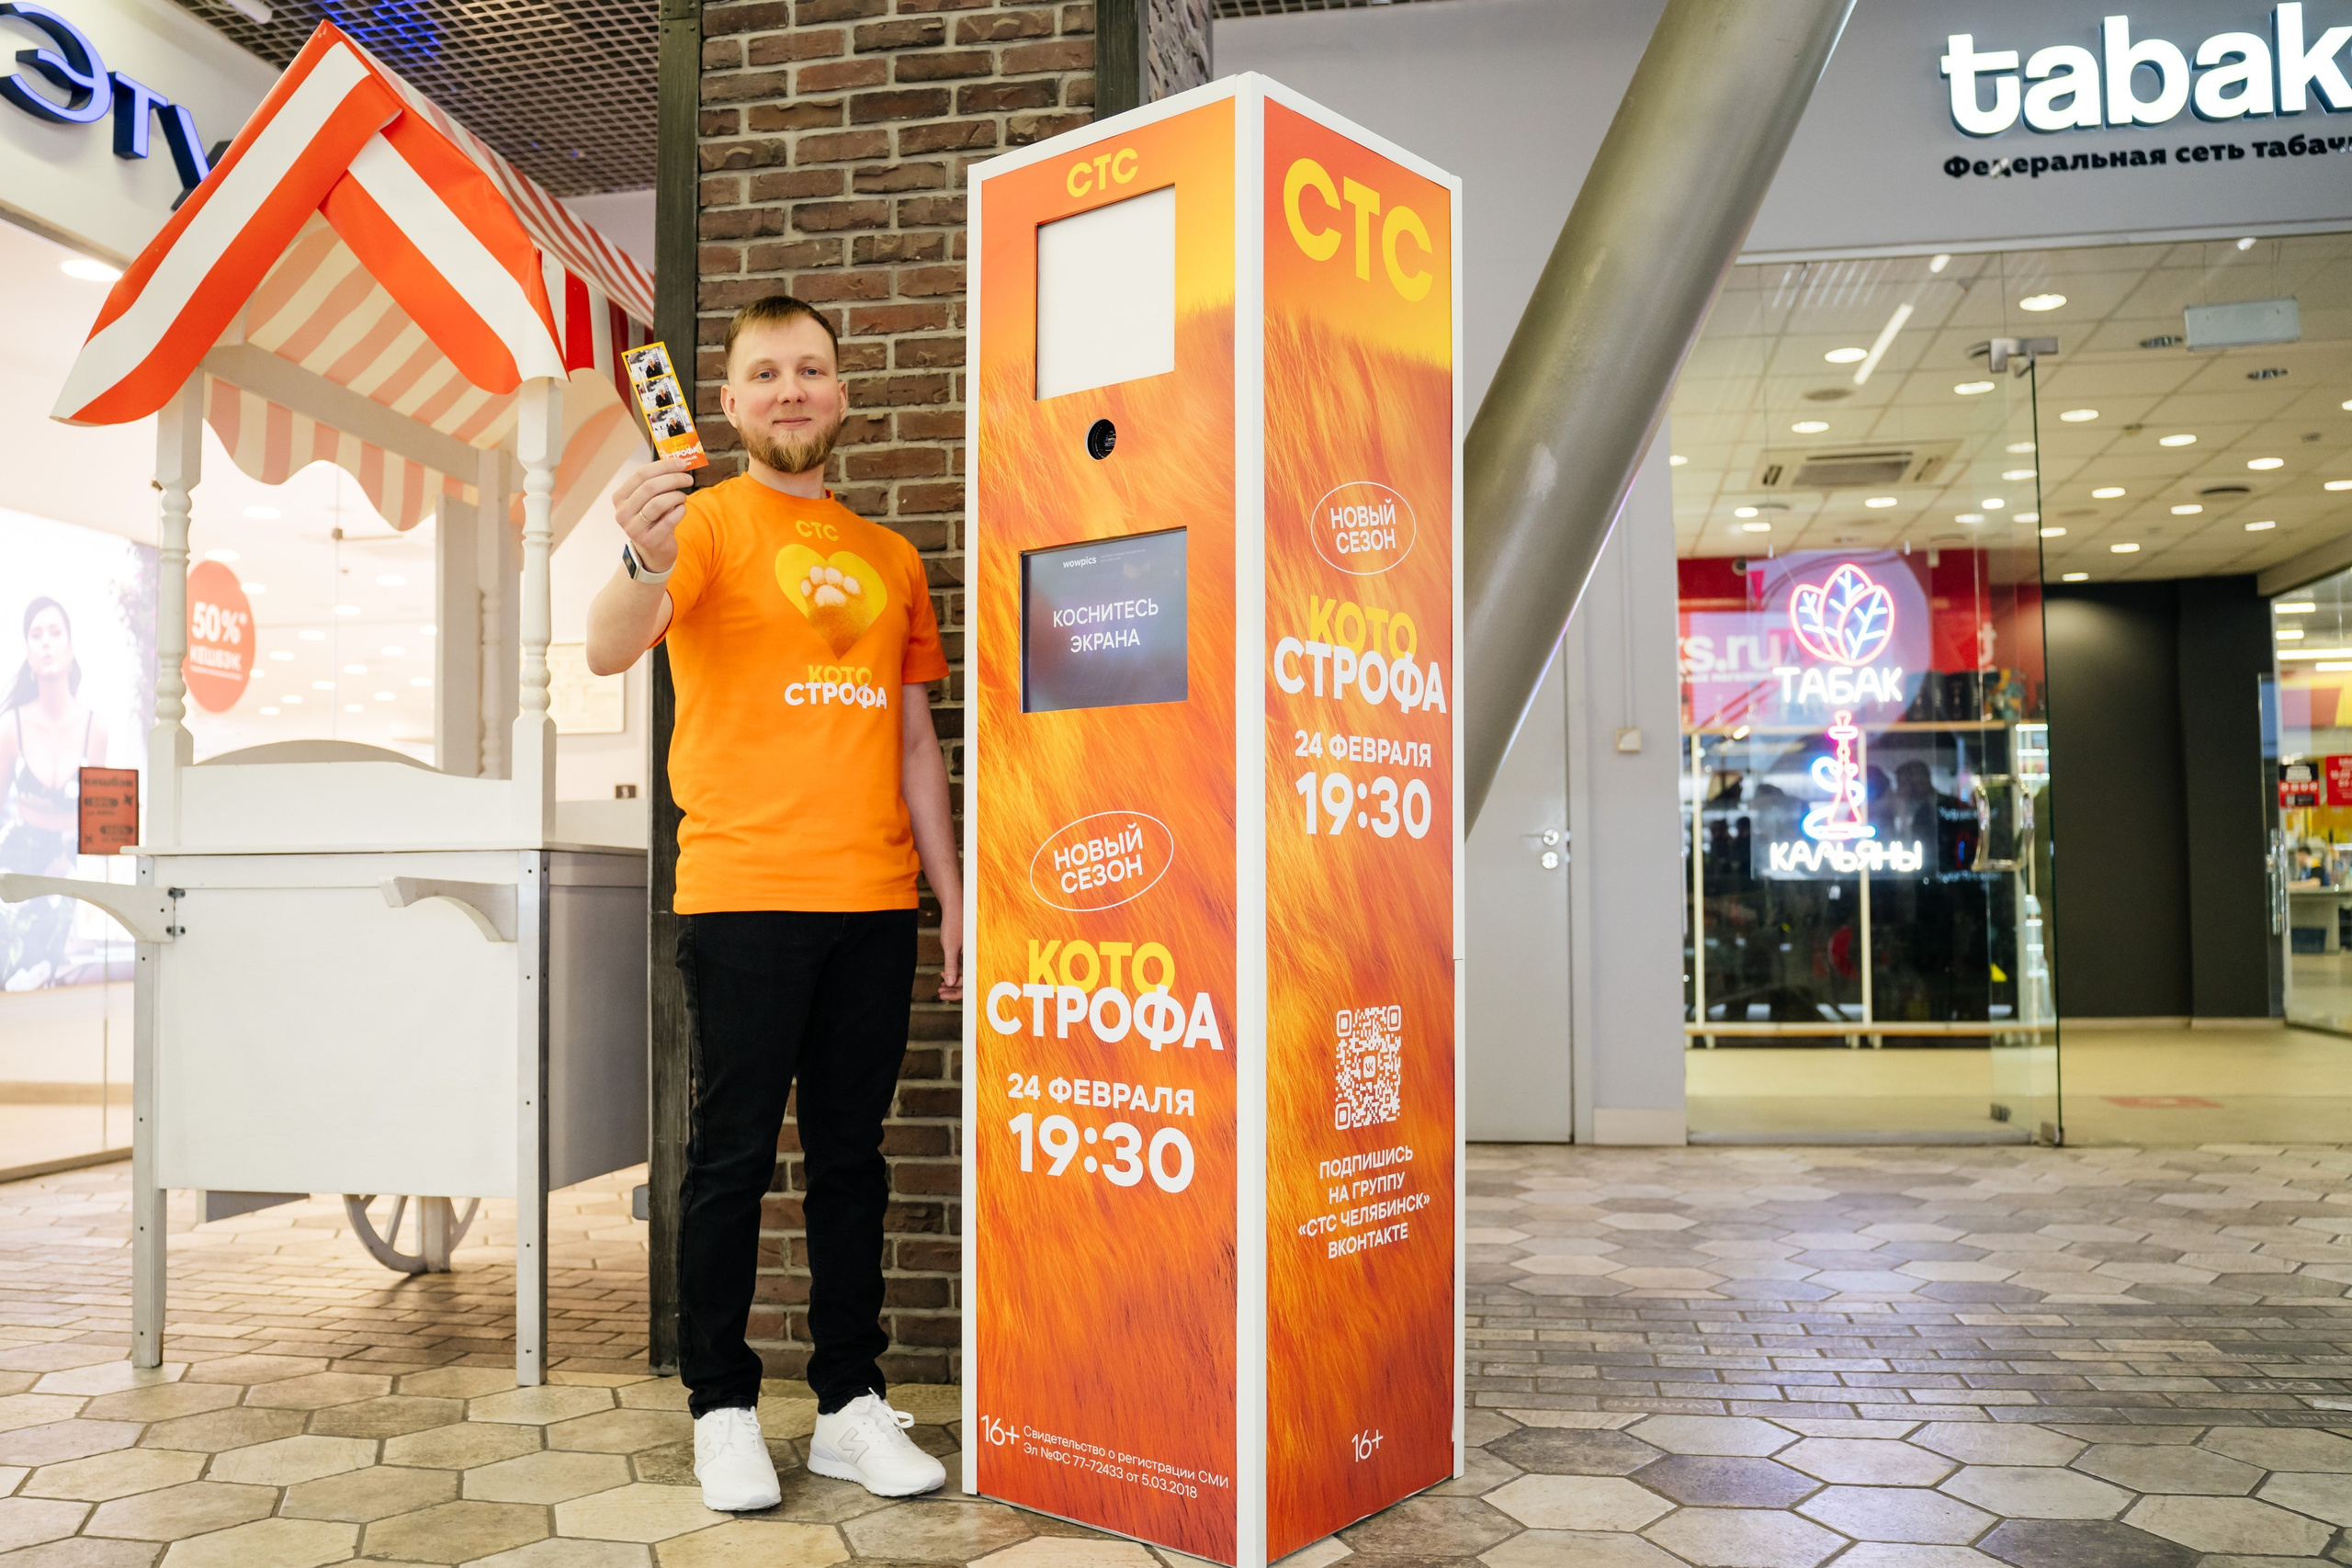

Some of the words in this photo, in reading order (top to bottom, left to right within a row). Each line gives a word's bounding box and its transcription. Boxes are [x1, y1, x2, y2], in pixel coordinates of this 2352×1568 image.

[2175, 141, 2245, 164] сеть
[1067, 148, 1138, 197] СТС
[1283, 158, 1433, 302] СТС
[795, 520, 839, 542] СТС
[1330, 498, 1396, 530] НОВЫЙ
[1335, 528, 1396, 554] СЕЗОН
[1062, 556, 1097, 569] wowpics
[1053, 598, 1159, 628] КОСНИТЕСЬ
[1309, 594, 1418, 662] КОТО
[1070, 628, 1141, 653] ЭКРАНА
[1678, 634, 1781, 673] s.ru
[808, 664, 873, 687] КОТО
[1273, 636, 1447, 715] СТРОФА
[1772, 666, 1903, 705] ТАБАК
[784, 682, 888, 709] СТРОФА
[1295, 729, 1323, 758] 24
[1329, 733, 1431, 768] ФЕВРАЛЯ
[1295, 772, 1431, 840] 19:30
[1054, 822, 1144, 871] НОВЫЙ
[1770, 840, 1923, 873] КАЛЬЯНЫ
[1060, 854, 1144, 894] СЕЗОН
[1028, 939, 1176, 995] КОТО
[986, 981, 1225, 1052] СТРОФА
[1008, 1072, 1041, 1100] 24
[1048, 1076, 1194, 1116] ФЕВРАЛЯ
[1008, 1112, 1195, 1194] 19:30
[1319, 1145, 1414, 1179] ПОДПИШИСЬ
[1329, 1184, 1350, 1205] НА
[1351, 1171, 1406, 1200] ГРУППУ
[1298, 1215, 1338, 1238] «СТС
[1340, 1192, 1430, 1228] ЧЕЛЯБИНСК»
[1328, 1223, 1408, 1259] ВКОНТАКТЕ
[980, 1415, 1020, 1446] 16+
[1351, 1429, 1384, 1462] 16+
[1023, 1425, 1106, 1457] Свидетельство
[1108, 1450, 1115, 1460] о
[1117, 1451, 1195, 1481] регистрации
[1198, 1470, 1229, 1489] СМИ
[1023, 1442, 1038, 1456] Эл
[1072, 1455, 1124, 1479] 77-72433
[1125, 1472, 1139, 1483] от
[1141, 1473, 1198, 1499] 5.03.2018
